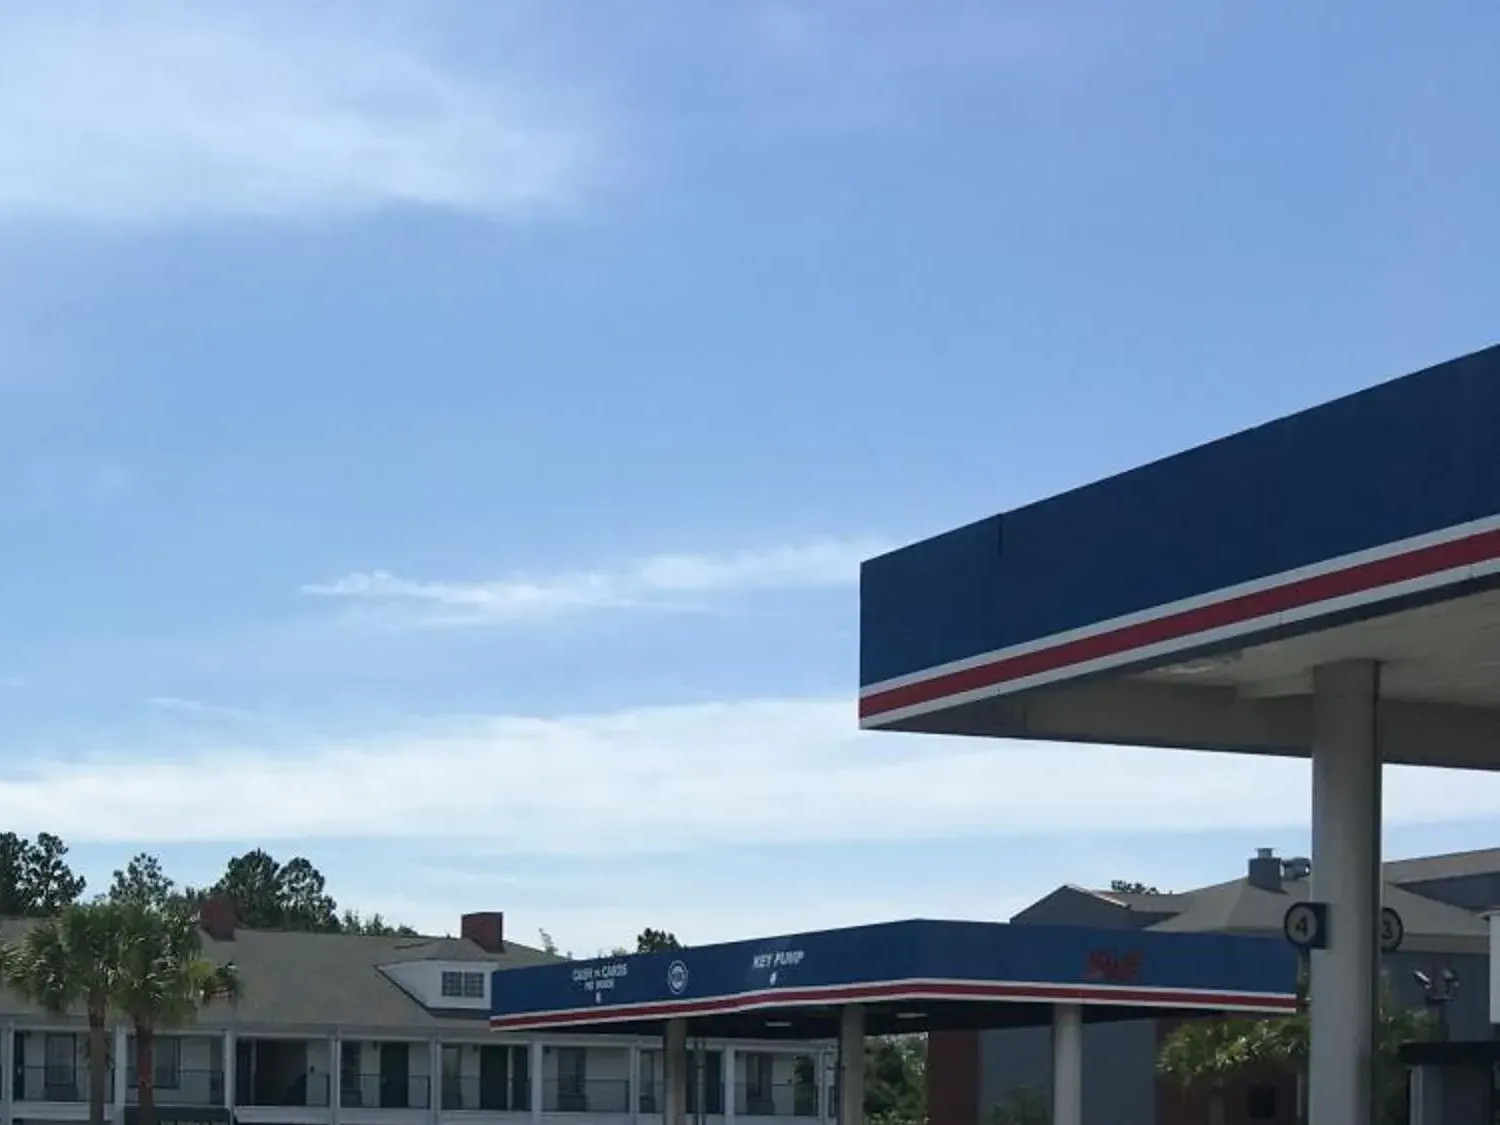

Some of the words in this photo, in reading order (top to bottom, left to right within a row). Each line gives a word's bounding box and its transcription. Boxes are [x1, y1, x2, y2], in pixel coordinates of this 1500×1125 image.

[1295, 916, 1308, 936] 4
[1382, 920, 1392, 939] 3
[752, 954, 772, 969] KEY
[773, 949, 805, 967] PUMP
